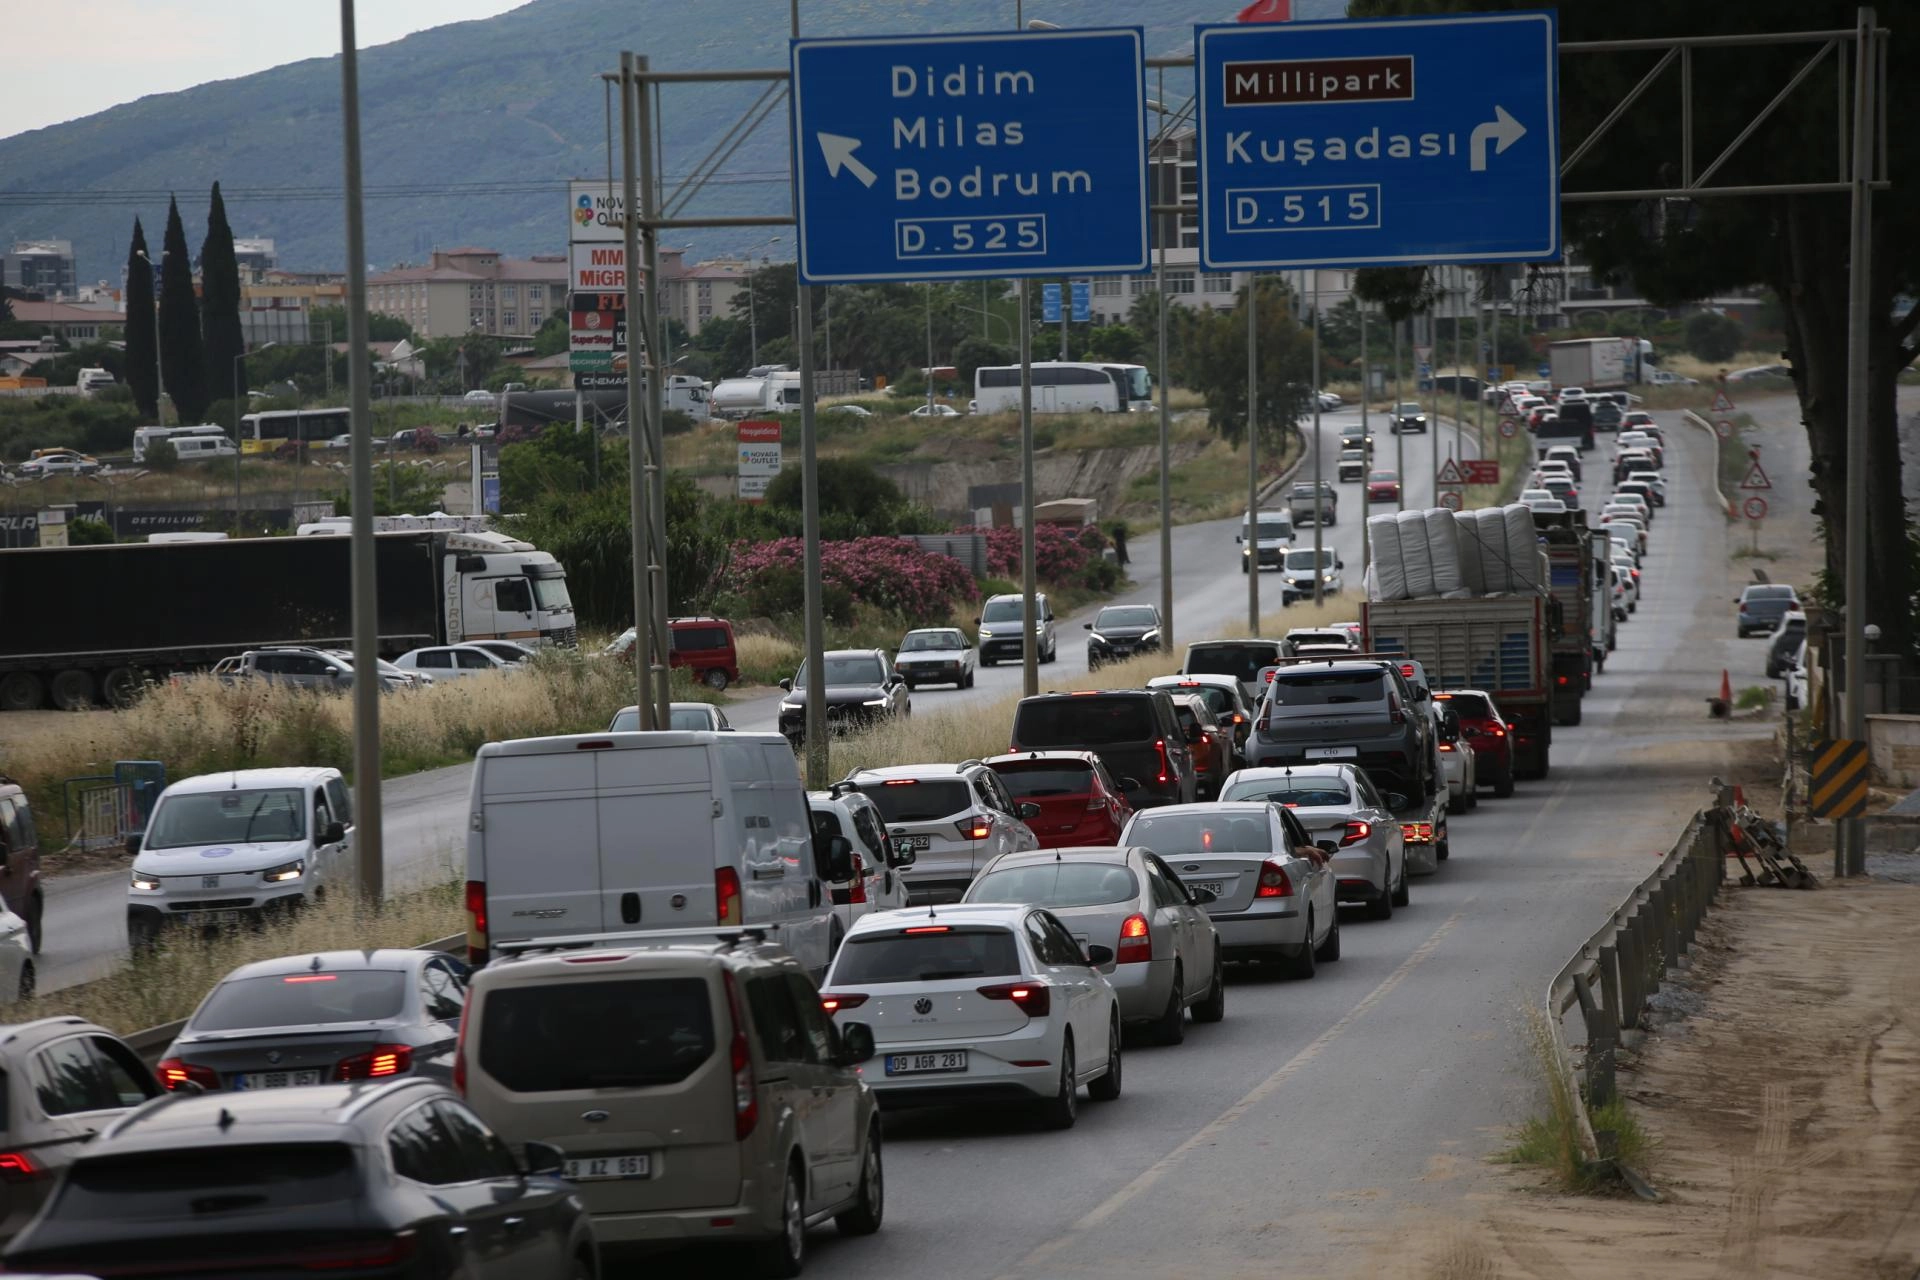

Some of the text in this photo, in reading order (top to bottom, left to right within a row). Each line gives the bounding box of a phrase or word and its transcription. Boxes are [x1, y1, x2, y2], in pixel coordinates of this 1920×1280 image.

[892, 64, 1035, 98] Didim
[1235, 67, 1402, 97] Millipark
[893, 116, 1024, 149] Milas
[1226, 128, 1456, 165] Kuşadası
[896, 165, 1092, 200] Bodrum
[131, 515, 205, 525] DETAILING
[894, 1053, 963, 1071] 09 AGR 281
